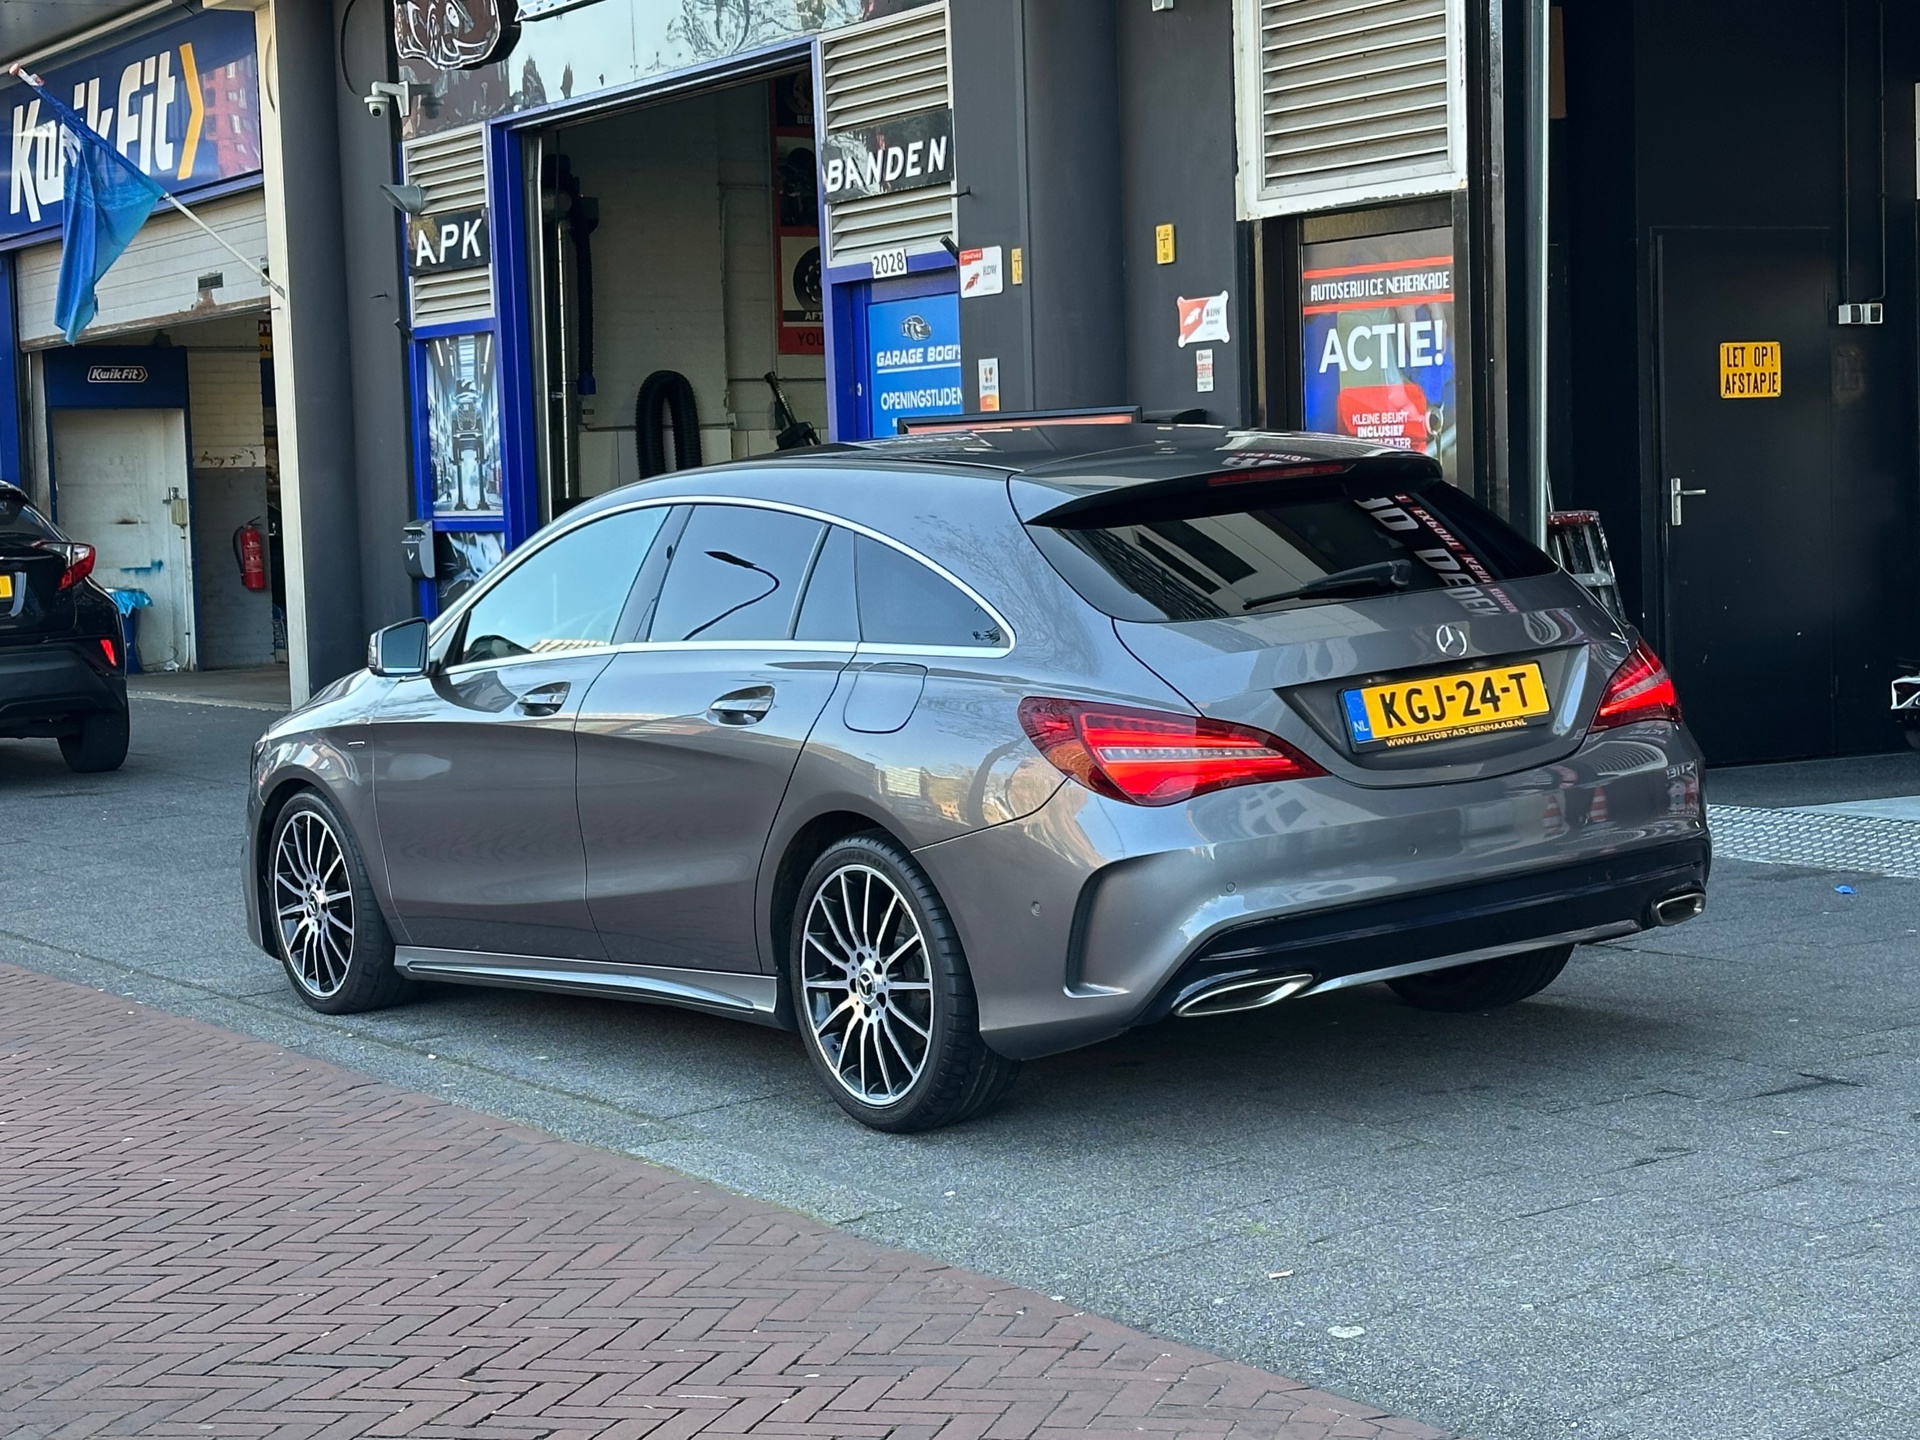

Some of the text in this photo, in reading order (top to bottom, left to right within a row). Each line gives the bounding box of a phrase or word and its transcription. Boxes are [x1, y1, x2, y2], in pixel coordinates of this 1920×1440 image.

[826, 136, 947, 193] BANDEN
[416, 218, 482, 267] APK
[873, 252, 904, 275] 2028
[1386, 271, 1450, 295] NEHERKADE
[876, 347, 924, 368] GARAGE
[1318, 320, 1444, 374] ACTIE!
[1726, 346, 1775, 368] LET OP!
[1724, 372, 1778, 395] AFSTAPJE
[1352, 410, 1409, 425] KLEINE BEURT
[1357, 425, 1405, 438] INCLUSIEF
[1379, 672, 1527, 729] KGJ-24-T
[1353, 719, 1370, 733] NL
[1386, 719, 1527, 748] WWW.AUTOSTAD-DENHAAG.NL
